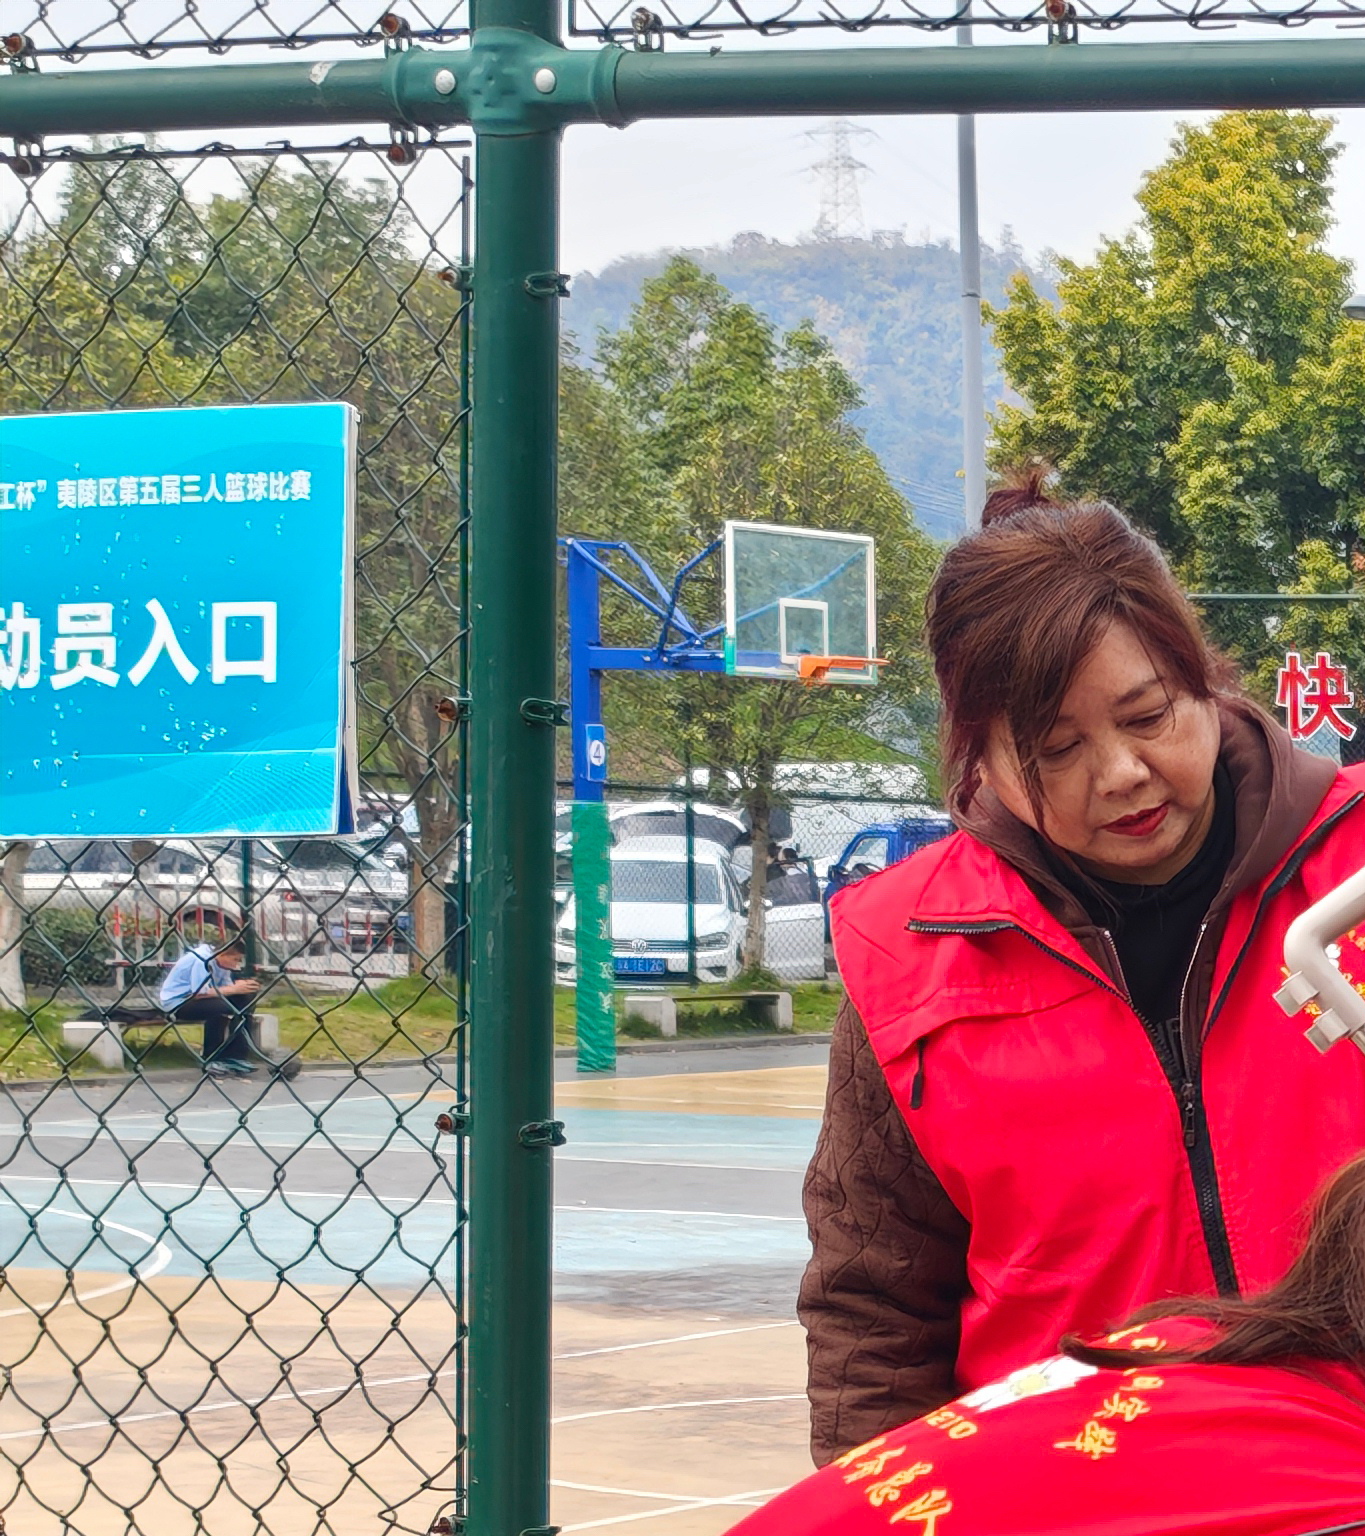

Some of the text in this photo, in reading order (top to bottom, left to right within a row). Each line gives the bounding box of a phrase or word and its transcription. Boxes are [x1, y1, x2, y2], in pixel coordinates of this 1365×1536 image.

[56, 469, 311, 509] 夷陵区第五届三人篮球比赛
[1276, 652, 1356, 740] 快
